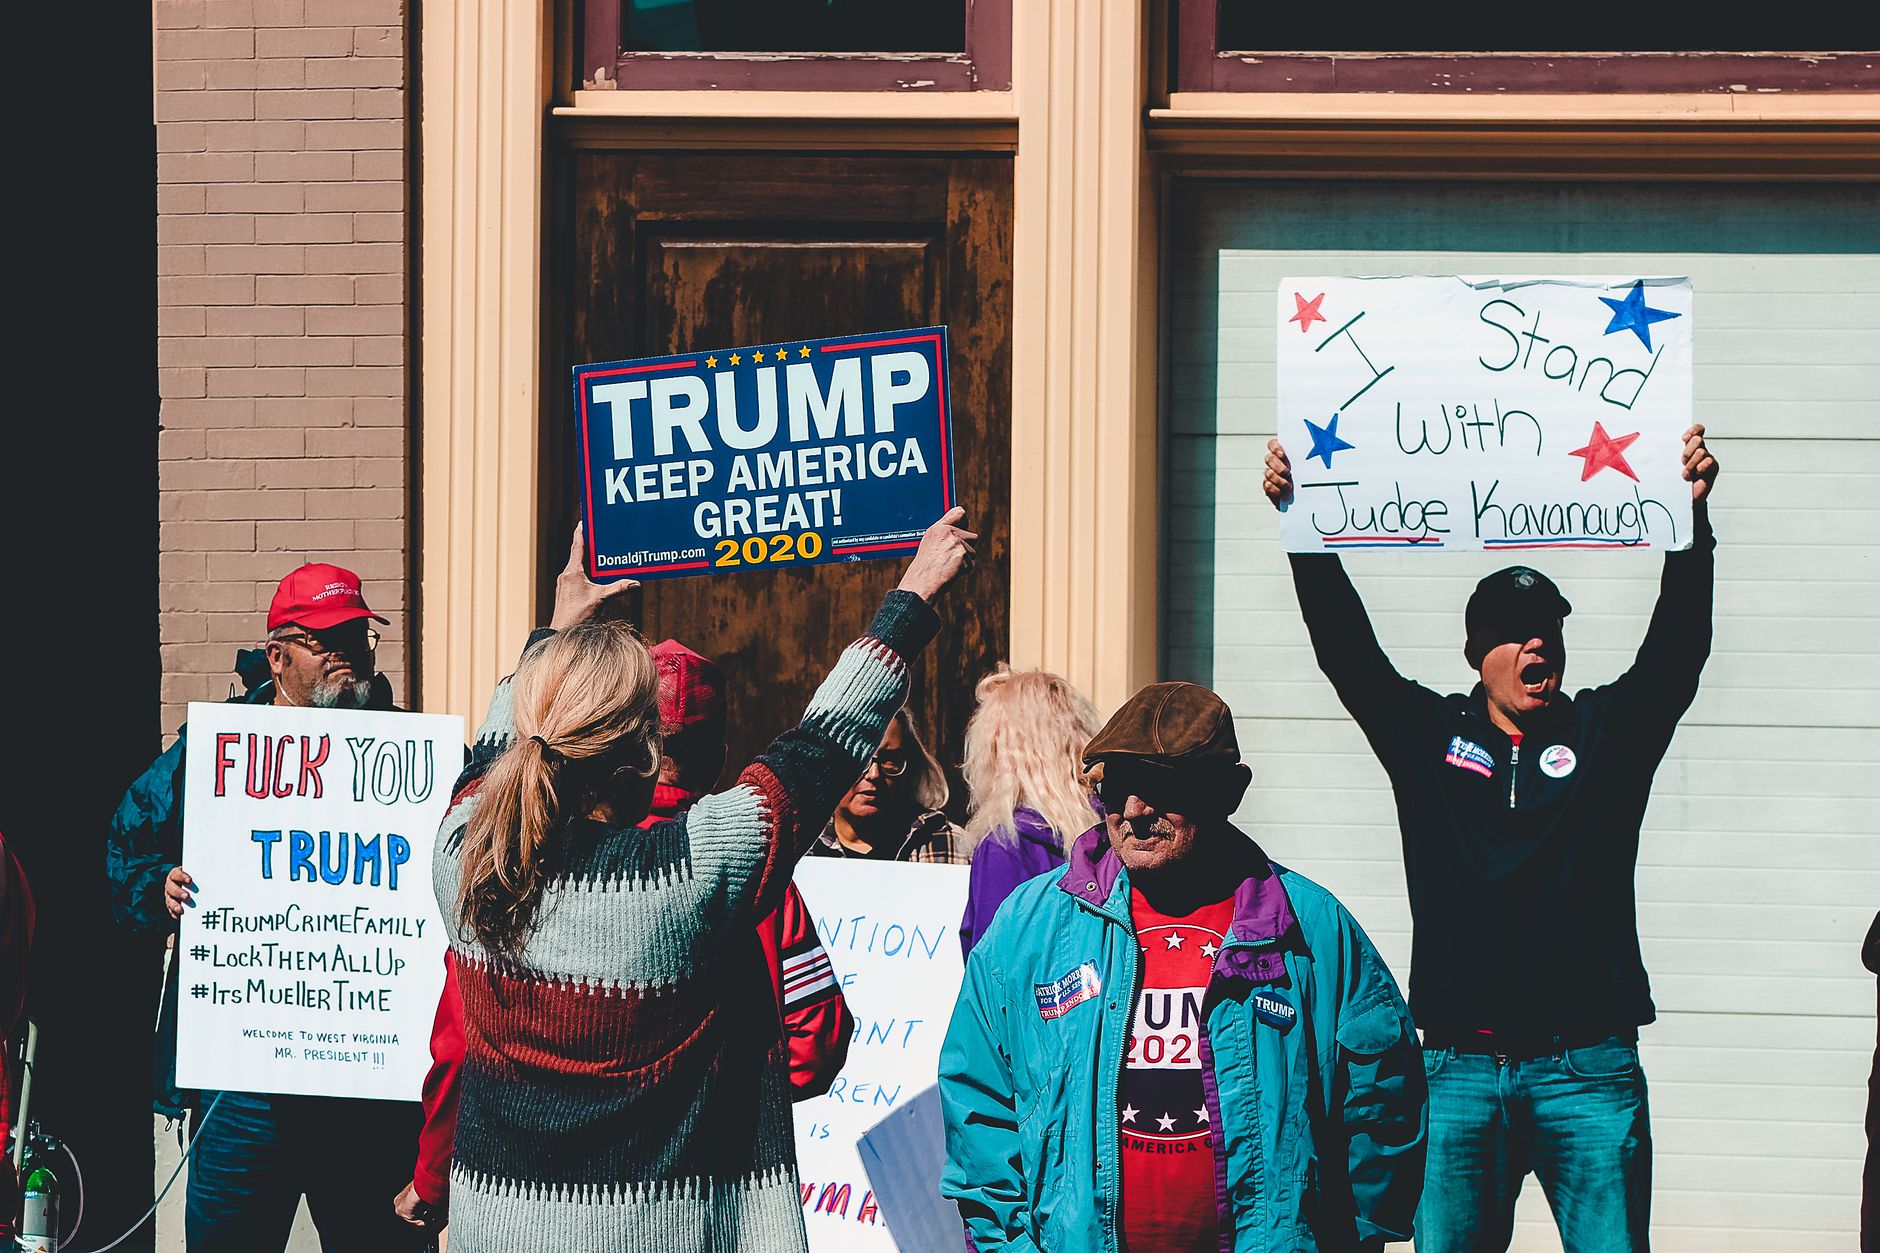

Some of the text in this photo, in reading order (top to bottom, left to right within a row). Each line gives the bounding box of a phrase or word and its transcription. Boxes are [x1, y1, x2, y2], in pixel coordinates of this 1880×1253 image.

[1314, 298, 1665, 411] I Stand
[592, 350, 931, 461] TRUMP
[604, 437, 928, 505] KEEP AMERICA
[692, 488, 843, 540] GREAT!
[1300, 479, 1677, 547] Judge Kavanaugh
[597, 546, 706, 568] DonaldjTrump.com
[714, 531, 823, 568] 2020
[213, 732, 433, 805] FUCK YOU
[250, 829, 411, 891] TRUMP
[1040, 1005, 1065, 1018] TRUMP
[1255, 995, 1295, 1018] TRUMP
[242, 1028, 400, 1046] WELCOME TO WEST VIRGINIA
[275, 1047, 297, 1060] MR.
[304, 1049, 369, 1064] PRESIDENT
[810, 1123, 831, 1140] IS
